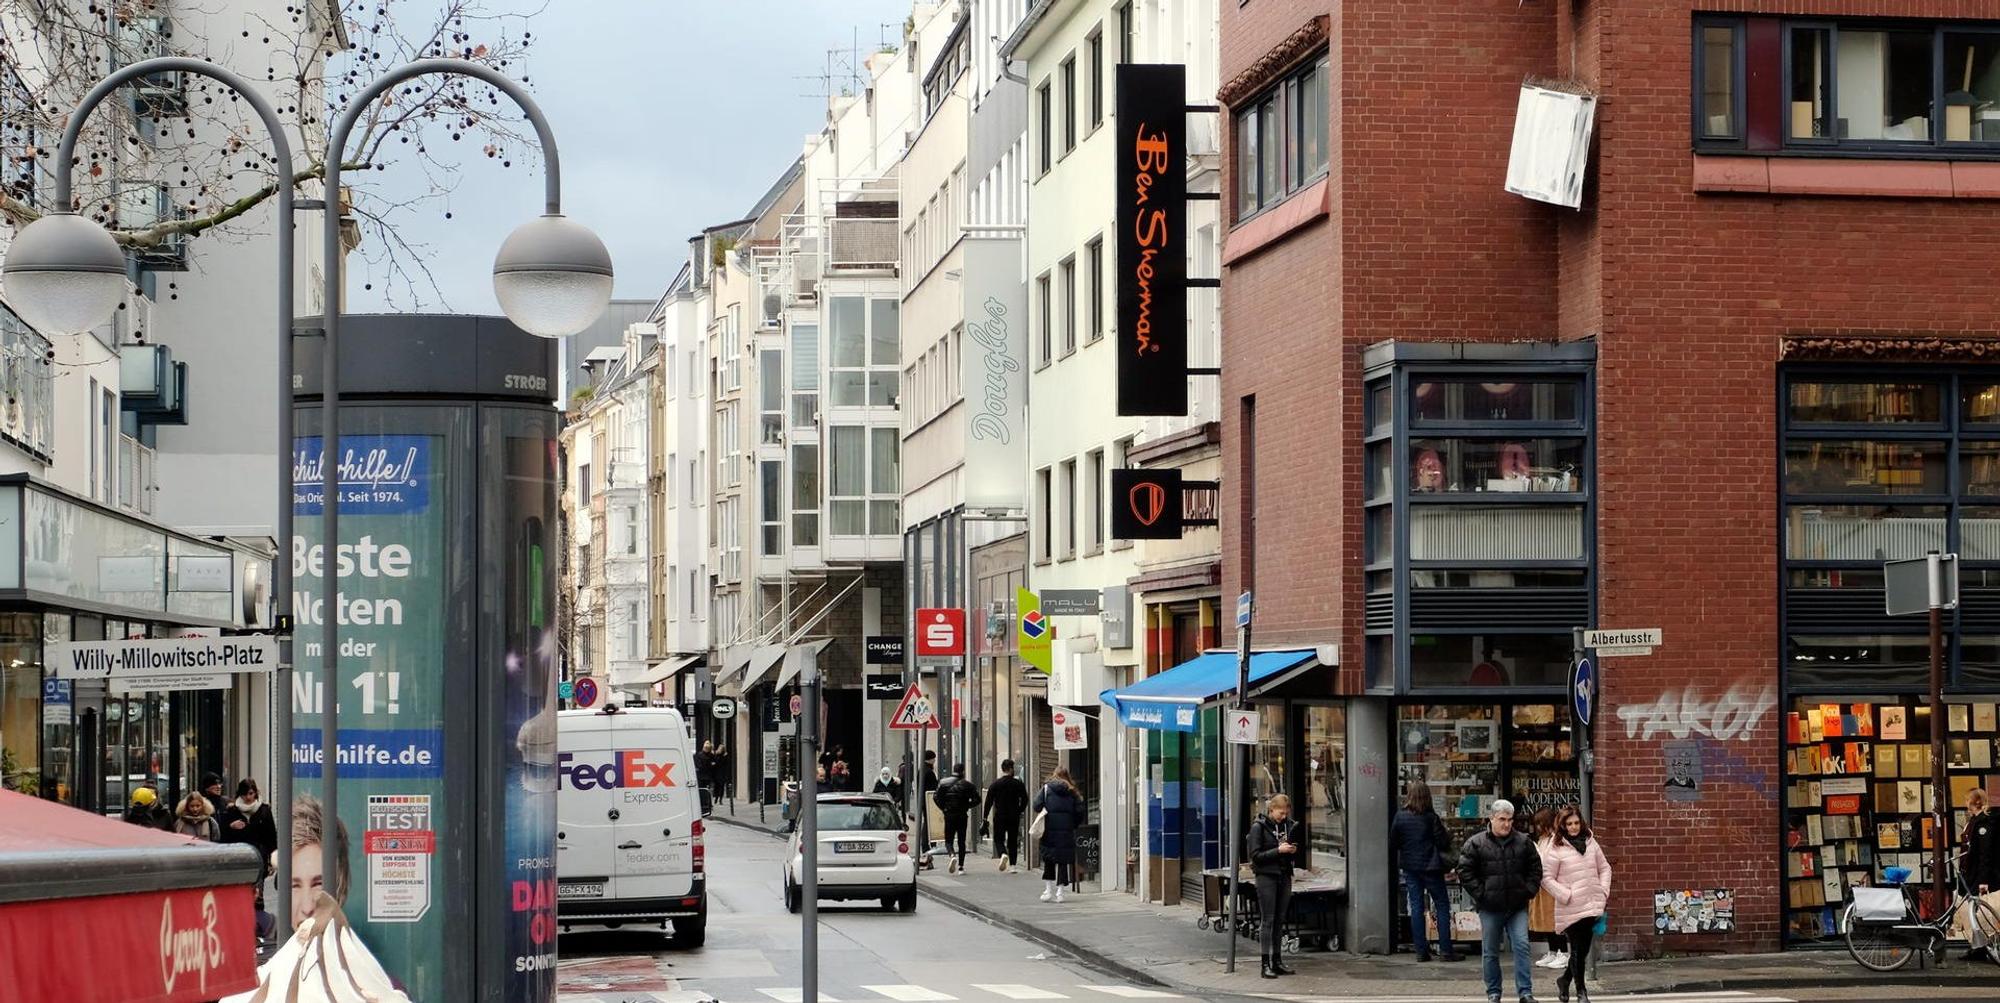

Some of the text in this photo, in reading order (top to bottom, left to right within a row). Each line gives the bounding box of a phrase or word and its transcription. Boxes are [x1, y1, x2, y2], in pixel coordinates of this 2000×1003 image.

[1136, 122, 1168, 357] Ben Sherman
[967, 297, 1020, 445] Douglas
[504, 374, 547, 391] STRÖER
[348, 491, 369, 502] Seit
[373, 491, 403, 502] 1974.
[293, 535, 412, 577] Beste
[186, 568, 222, 576] YAYA
[280, 617, 287, 629] 1
[1591, 632, 1654, 645] Albertusstr.
[340, 638, 376, 657] der
[72, 645, 264, 675] Willy-Millowitsch-Platz
[713, 705, 734, 713] ONLY
[1616, 684, 1778, 741] TAKO!
[557, 751, 677, 791] FedEx
[624, 791, 669, 805] Express
[371, 813, 427, 830] TEST
[626, 853, 680, 863] fedex.com
[202, 890, 225, 969] B.
